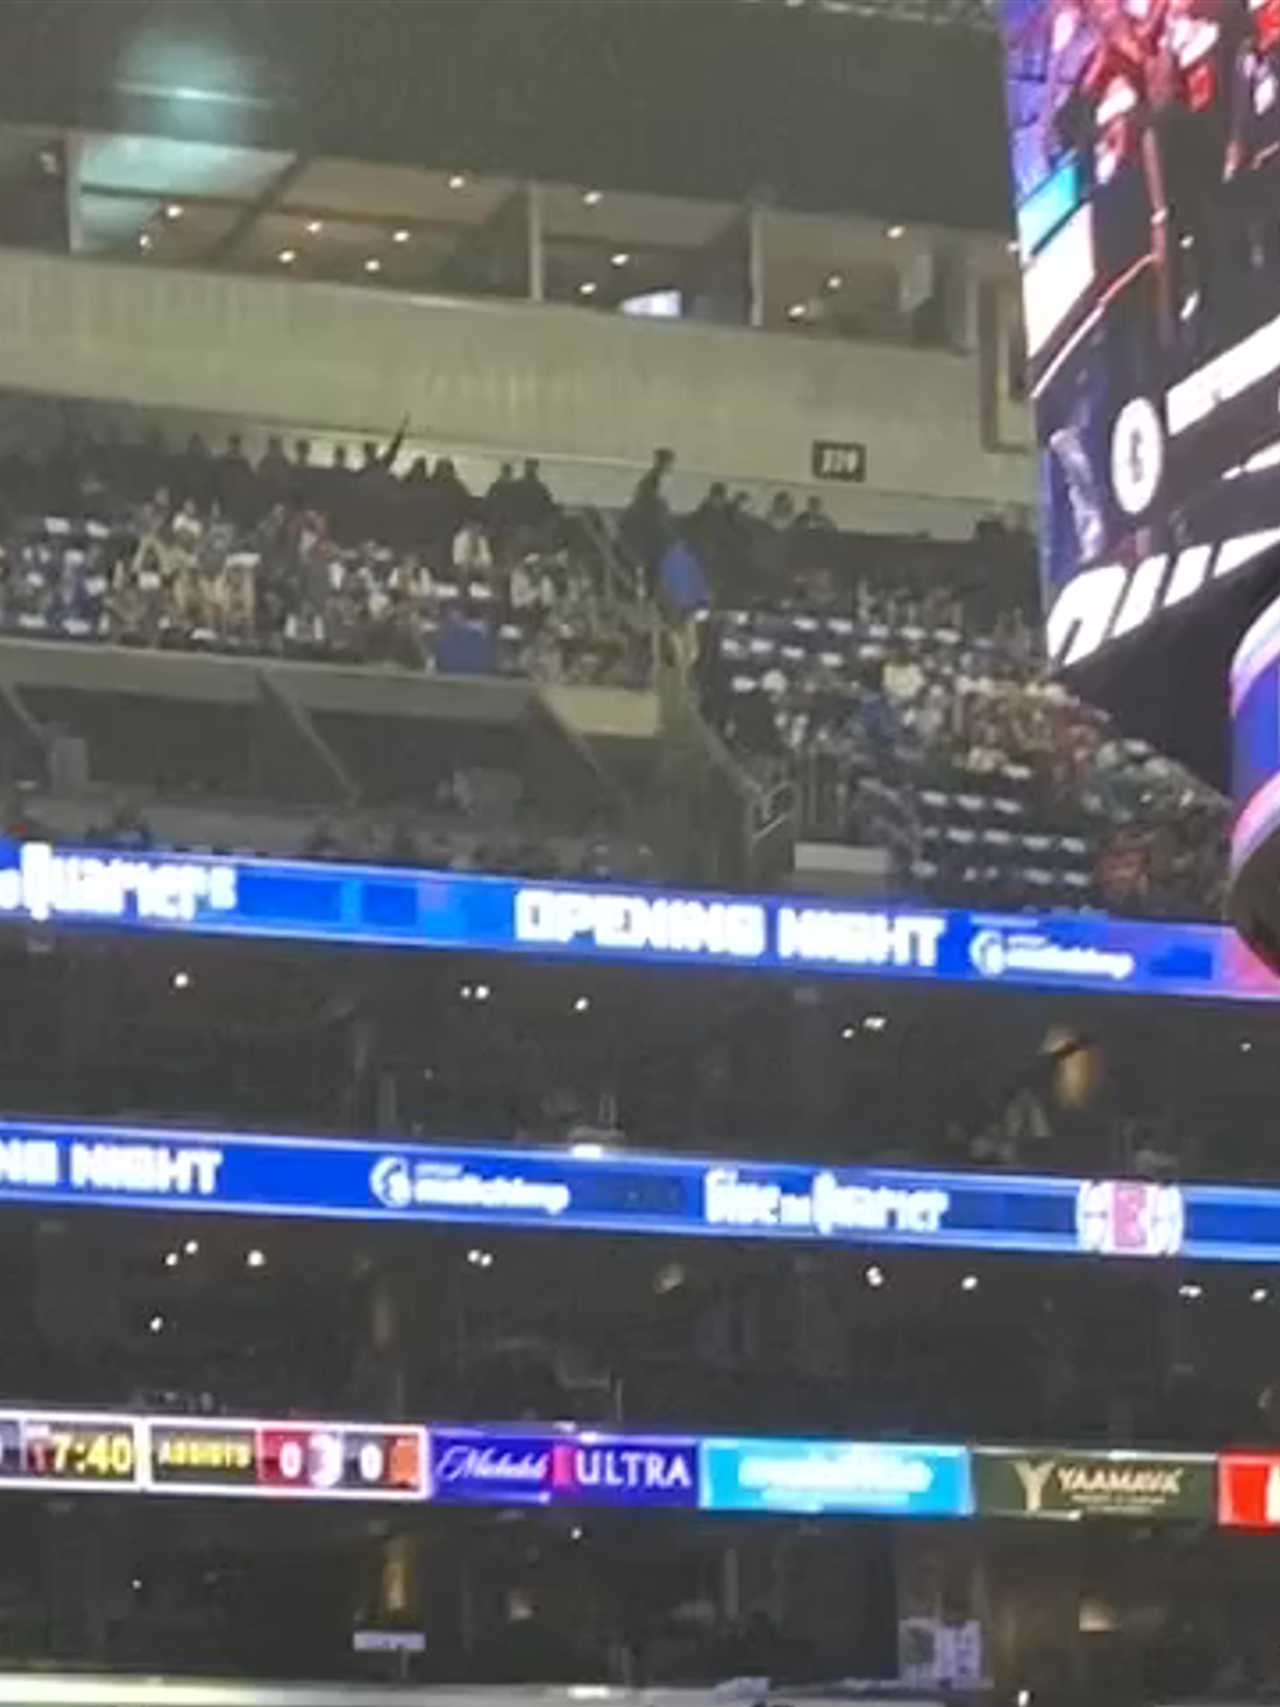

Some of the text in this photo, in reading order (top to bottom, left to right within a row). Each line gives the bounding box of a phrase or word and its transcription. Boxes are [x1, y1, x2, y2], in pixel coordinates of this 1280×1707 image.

[516, 890, 765, 958] OPENING
[778, 907, 946, 967] NIGHT
[71, 1143, 223, 1194] NIGHT
[55, 1433, 132, 1473] 7:40
[280, 1440, 302, 1477] 0
[360, 1443, 382, 1481] 0
[576, 1449, 691, 1489] ULTRA
